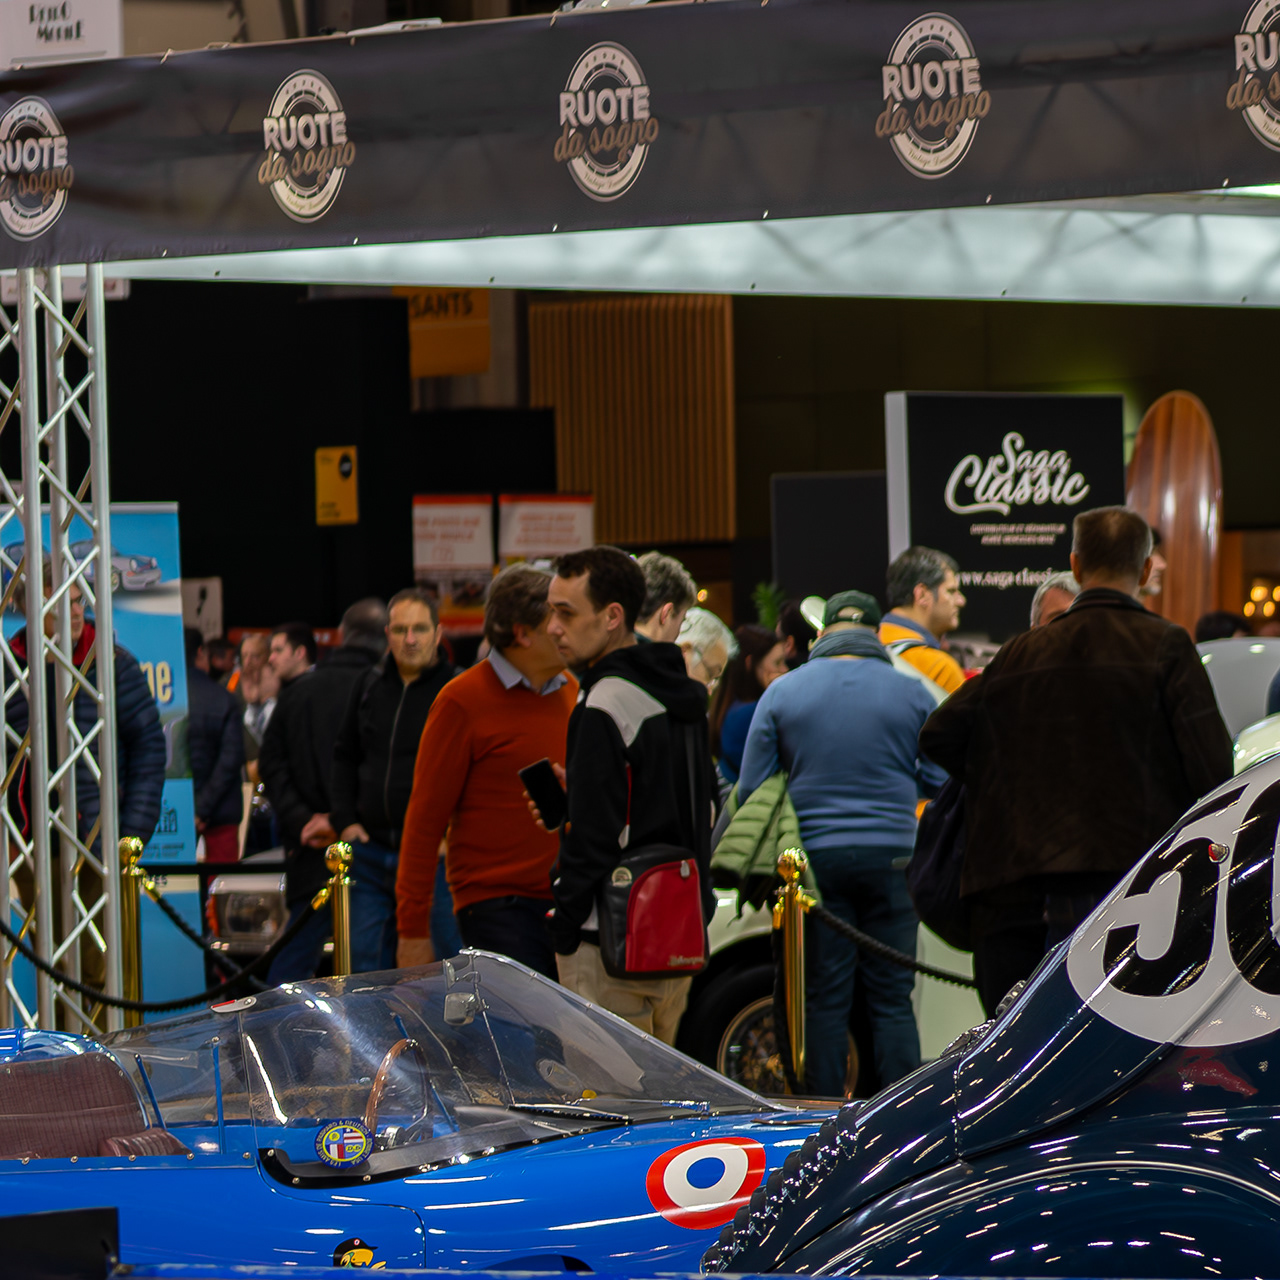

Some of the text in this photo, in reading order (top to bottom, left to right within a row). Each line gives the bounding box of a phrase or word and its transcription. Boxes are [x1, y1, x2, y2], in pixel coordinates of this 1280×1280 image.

[882, 58, 982, 102] RUOTE
[1226, 64, 1265, 110] da
[559, 85, 650, 127] RUOTE
[875, 90, 992, 139] da sogno
[263, 111, 348, 151] RUOTE
[553, 117, 660, 164] da sogno
[257, 141, 356, 185] da sogno
[992, 431, 1072, 481] Saga
[944, 454, 1091, 516] Classic
